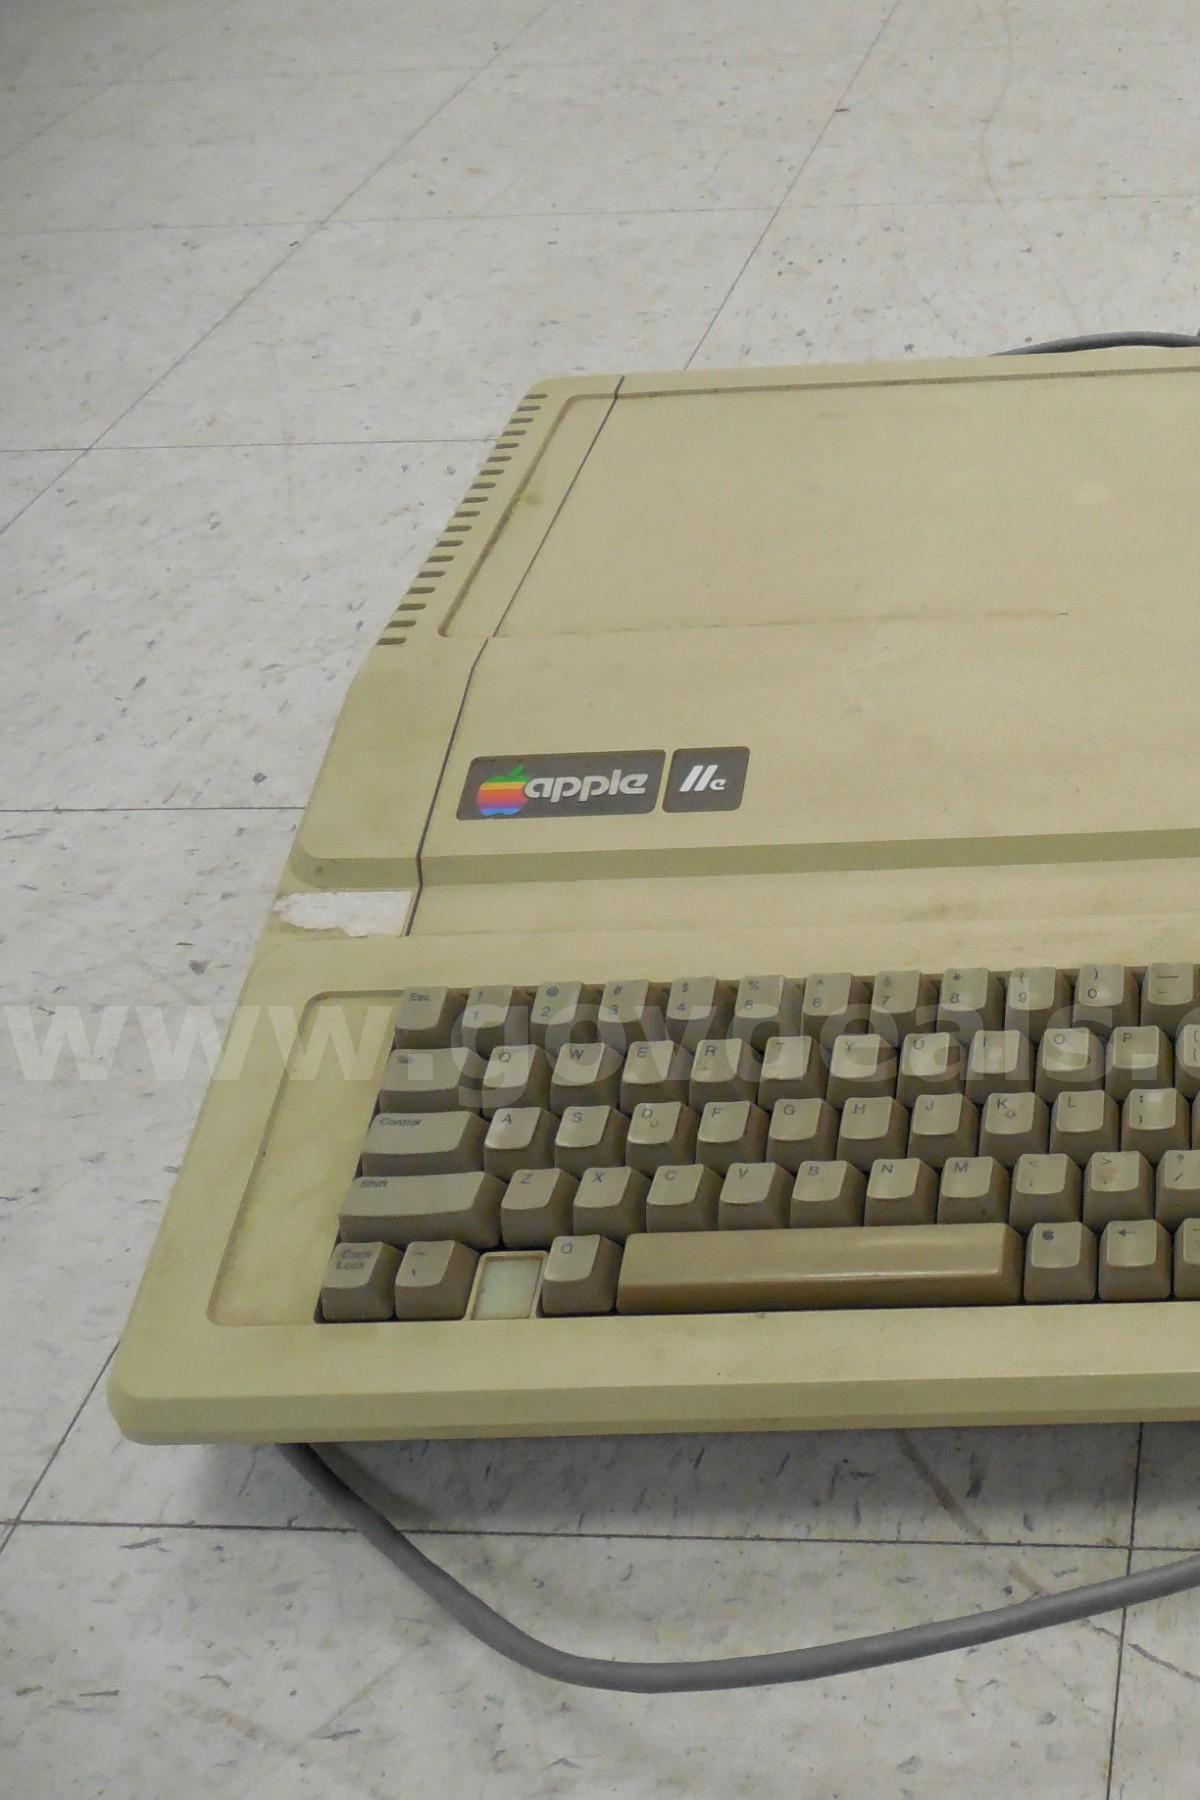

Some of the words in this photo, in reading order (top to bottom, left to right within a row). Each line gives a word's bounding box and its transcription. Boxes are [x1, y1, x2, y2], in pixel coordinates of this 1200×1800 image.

[523, 768, 649, 803] apple
[545, 985, 560, 997] @
[680, 982, 690, 993] $
[408, 991, 431, 1002] Esc
[881, 994, 892, 1006] 7
[950, 992, 960, 1004] 8
[1018, 991, 1028, 1004] 9
[811, 997, 822, 1009] 6
[540, 1006, 551, 1017] 2
[608, 1005, 619, 1016] 3
[1122, 1032, 1134, 1043] P
[775, 1041, 788, 1052] T
[843, 1040, 856, 1052] Y
[913, 1038, 925, 1050] U
[570, 1048, 585, 1061] W
[636, 1046, 649, 1059] E
[704, 1044, 717, 1057] R
[925, 1099, 935, 1112] J
[996, 1098, 1008, 1110] K
[1067, 1096, 1077, 1109] L
[711, 1106, 723, 1118] F
[783, 1104, 796, 1116] G
[852, 1103, 866, 1115] H
[379, 1116, 422, 1127] Control
[501, 1113, 513, 1125] A
[571, 1111, 583, 1124] S
[737, 1167, 749, 1178] V
[807, 1165, 820, 1177] B
[881, 1163, 893, 1174] N
[953, 1161, 968, 1173] M
[519, 1173, 531, 1185] Z
[591, 1171, 605, 1183] X
[664, 1169, 677, 1181] C
